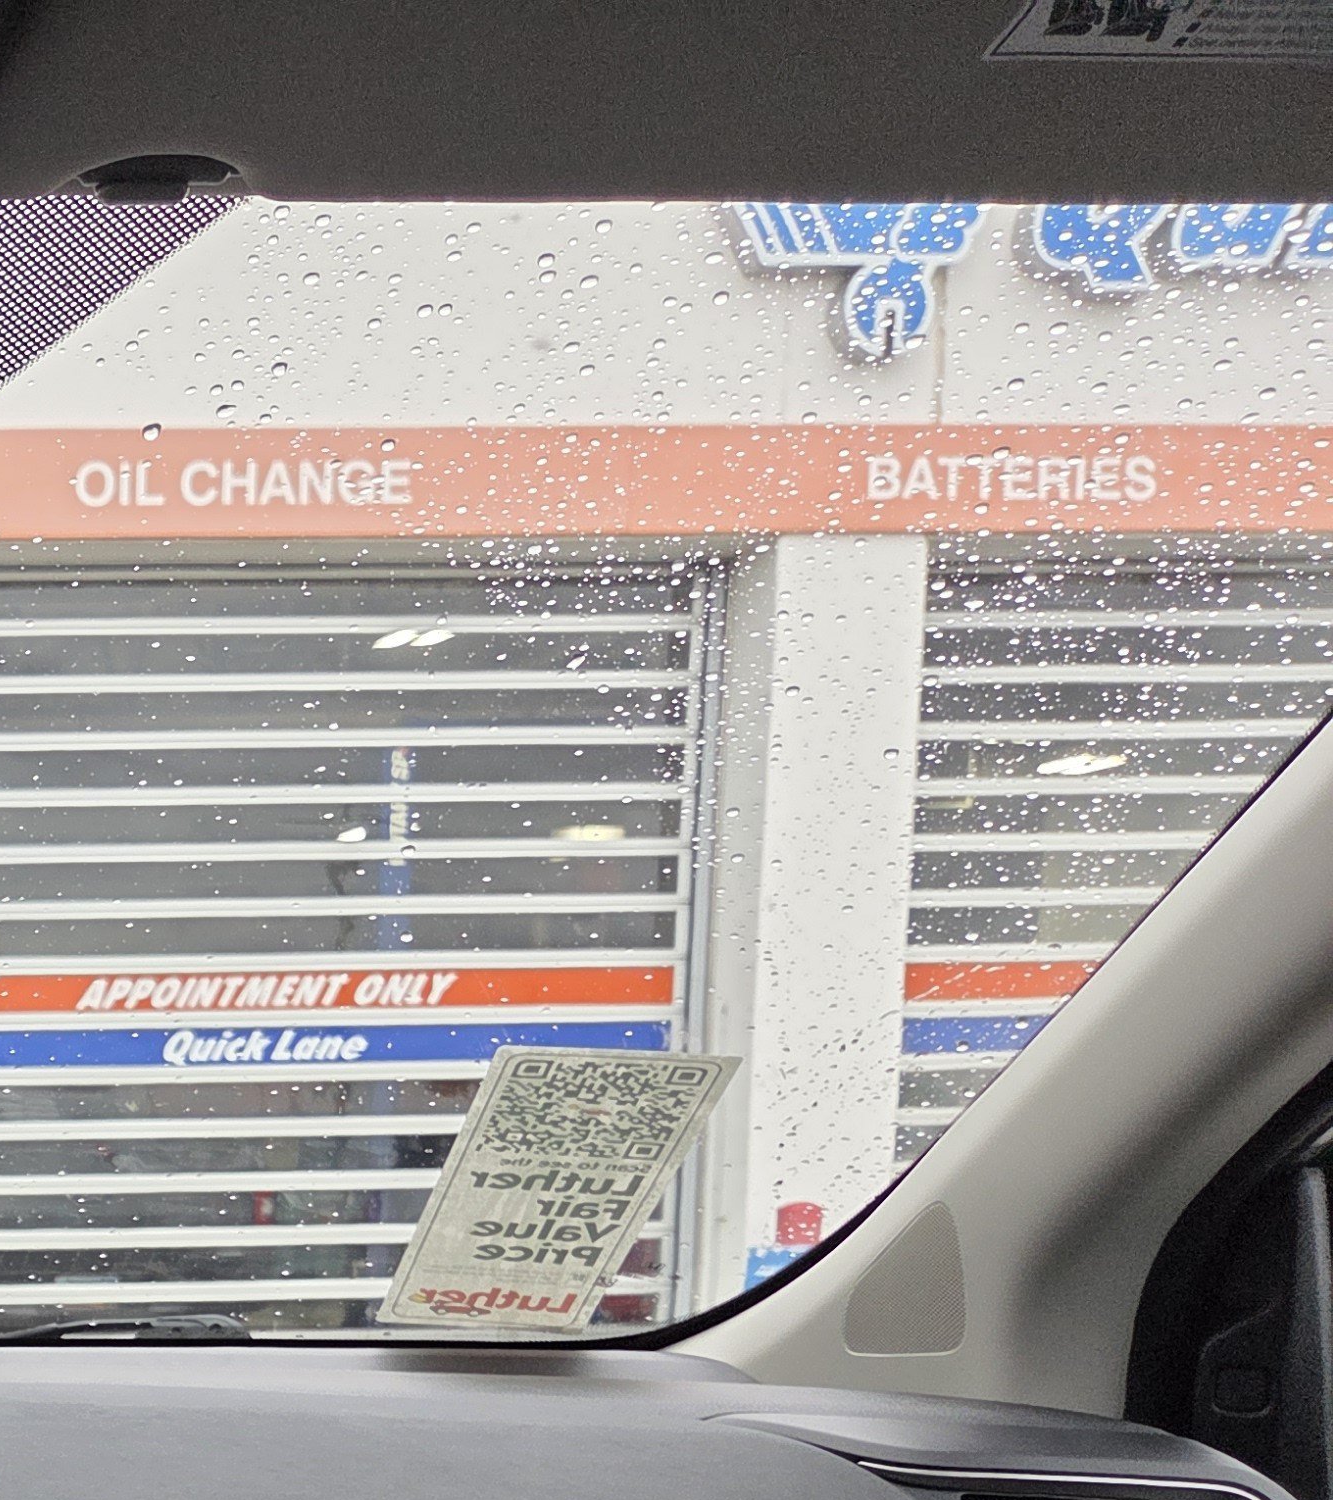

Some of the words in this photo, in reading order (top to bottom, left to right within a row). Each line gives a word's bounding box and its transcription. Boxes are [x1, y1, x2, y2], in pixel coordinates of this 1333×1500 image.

[180, 458, 413, 507] CHANGE
[866, 454, 1158, 503] BATTERIES
[76, 973, 349, 1011] APPOINTMENT
[353, 972, 459, 1006] ONLY
[162, 1029, 272, 1066] Quick
[270, 1029, 370, 1062] Lane
